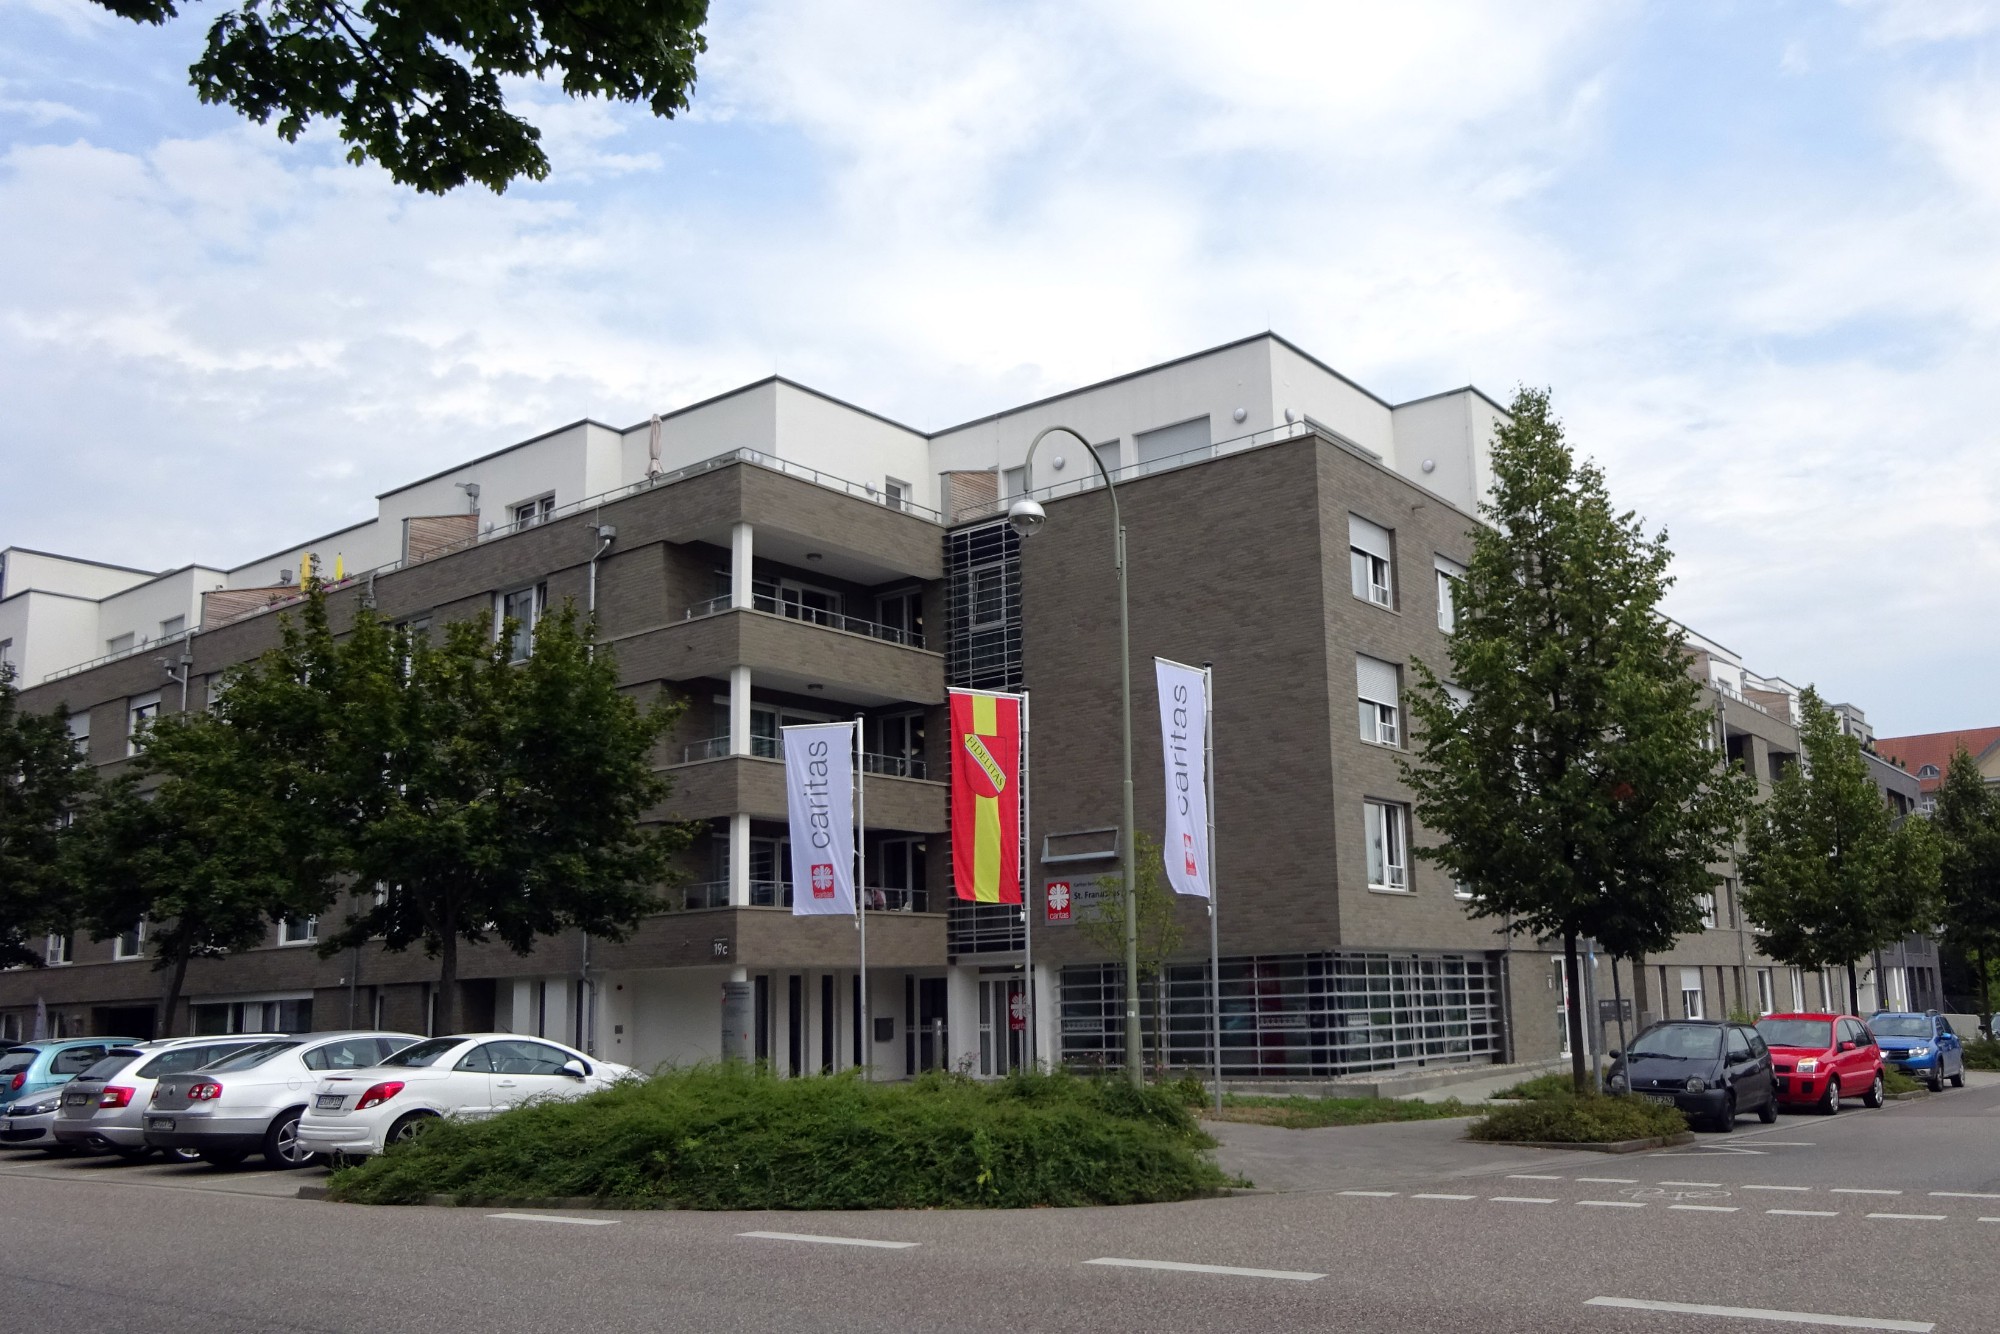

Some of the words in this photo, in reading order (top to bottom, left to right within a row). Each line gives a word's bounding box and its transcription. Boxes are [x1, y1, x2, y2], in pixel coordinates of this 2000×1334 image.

[966, 735, 1004, 787] FIDELITAS
[1170, 685, 1189, 815] caritas
[803, 740, 829, 849] caritas
[1049, 912, 1069, 920] caritas
[714, 942, 728, 956] 19c
